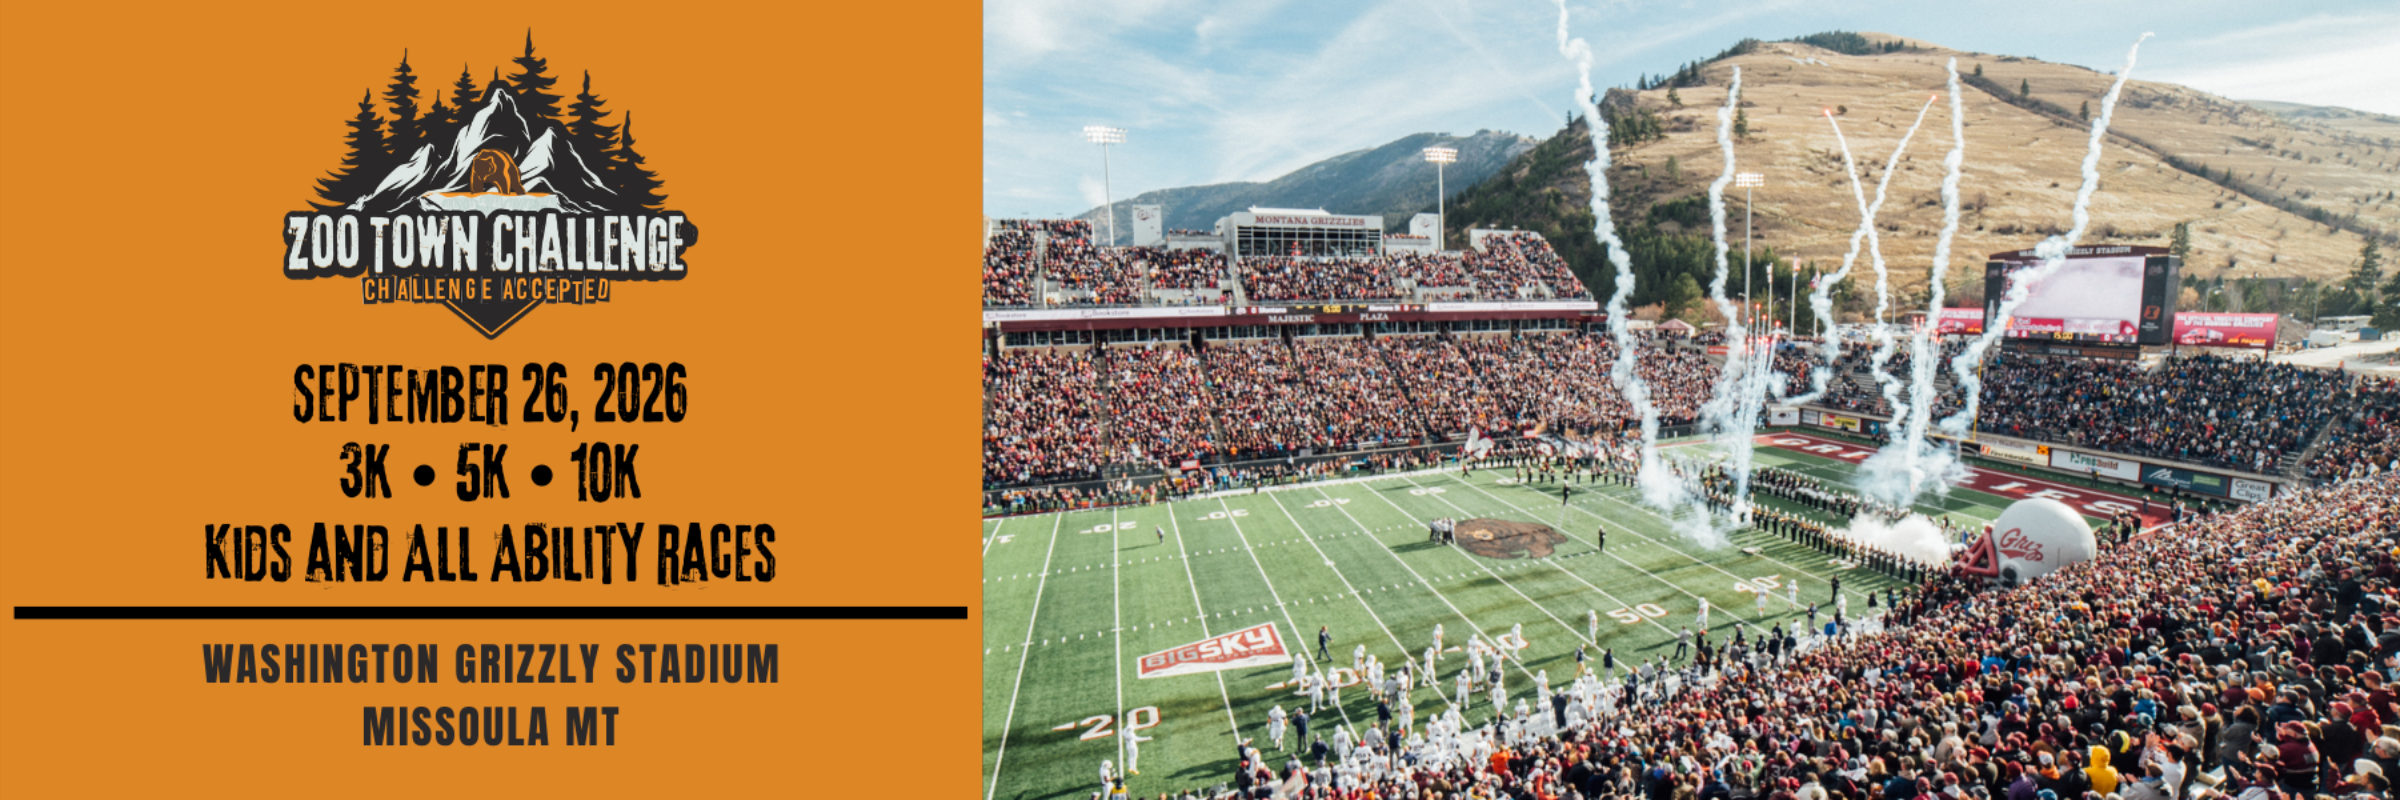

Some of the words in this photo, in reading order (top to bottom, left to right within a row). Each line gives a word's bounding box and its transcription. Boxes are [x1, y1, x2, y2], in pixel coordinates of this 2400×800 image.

[1255, 215, 1308, 225] MONTANA
[1311, 216, 1365, 226] GRIZZLIES
[2096, 246, 2131, 254] STADIUM
[1268, 314, 1315, 323] MAJESTIC
[1360, 313, 1389, 321] PLAZA
[2235, 480, 2266, 492] Great
[2000, 527, 2045, 562] Griz
[1606, 602, 1669, 624] 50
[1079, 705, 1162, 742] 20
